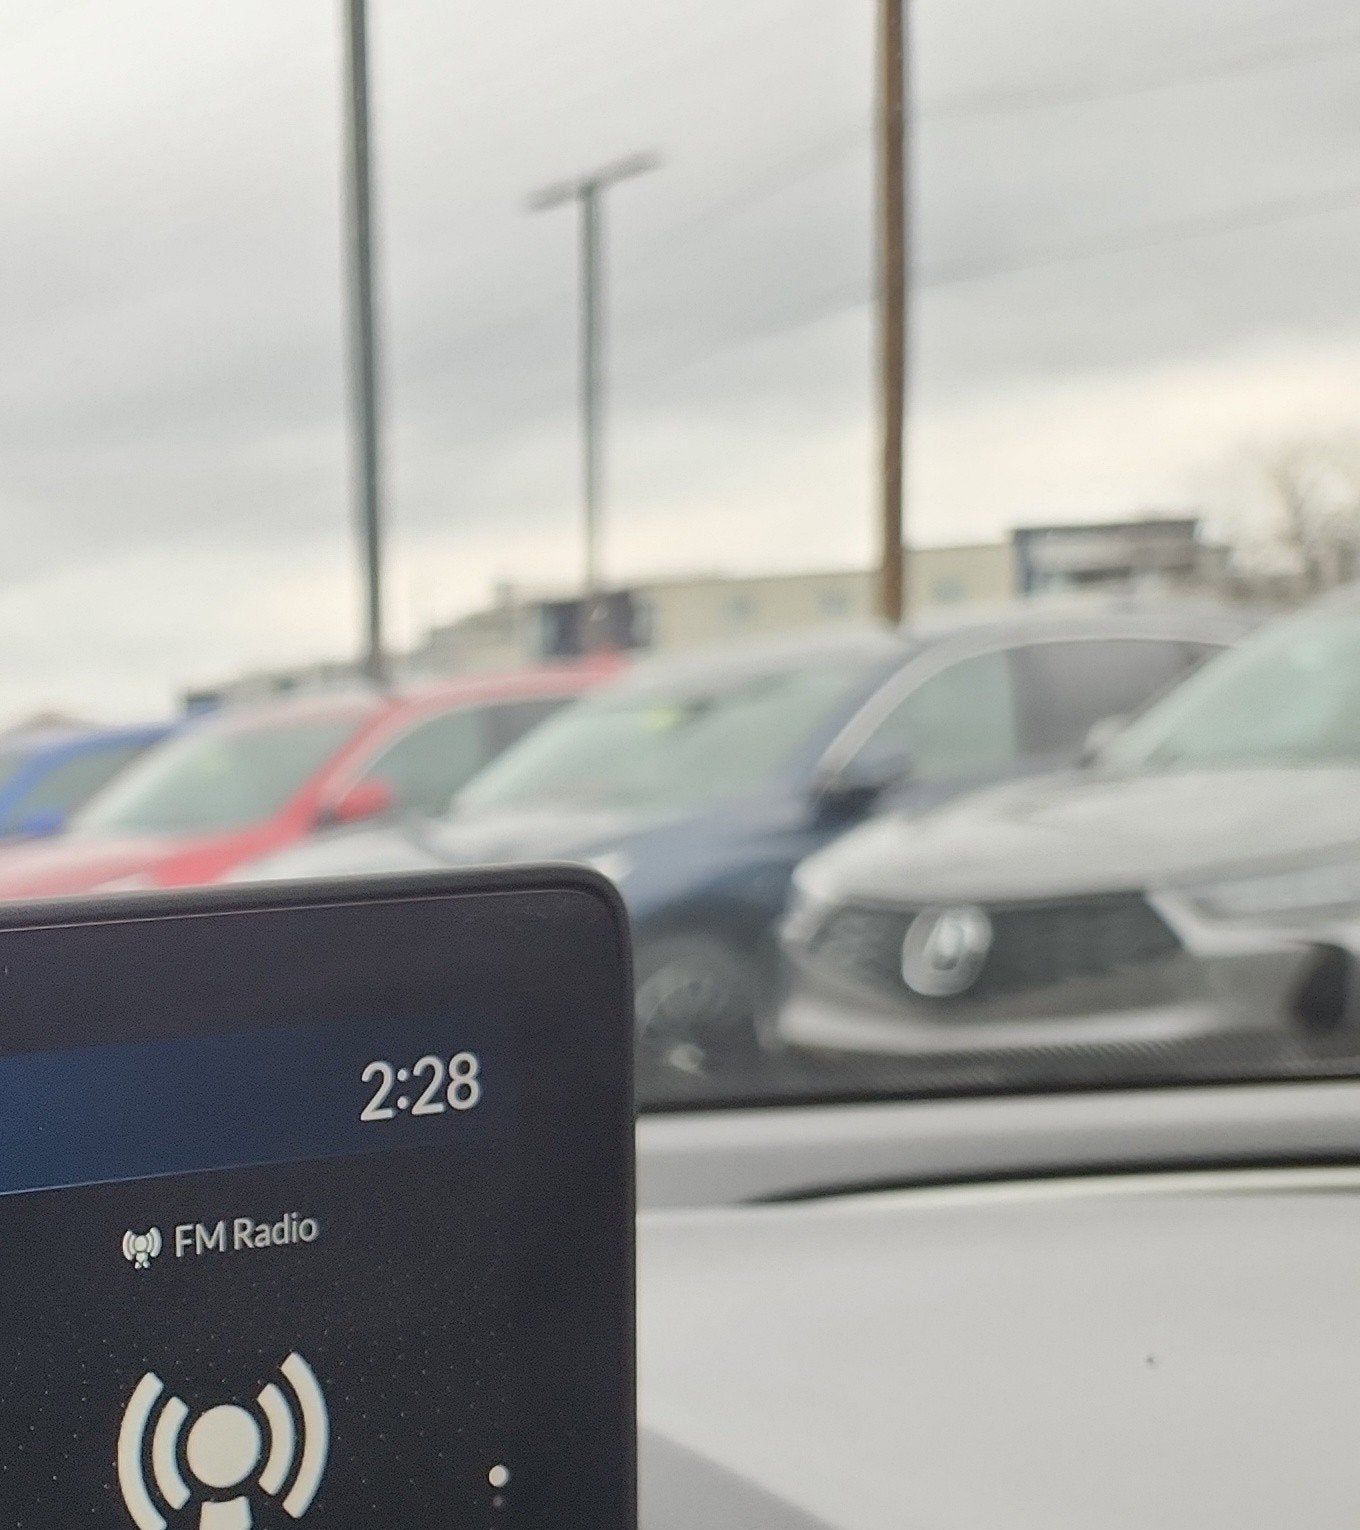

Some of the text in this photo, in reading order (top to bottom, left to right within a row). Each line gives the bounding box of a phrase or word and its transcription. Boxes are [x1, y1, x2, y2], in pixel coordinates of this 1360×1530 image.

[360, 1051, 481, 1121] 2:28
[175, 1212, 319, 1258] FM Radio
